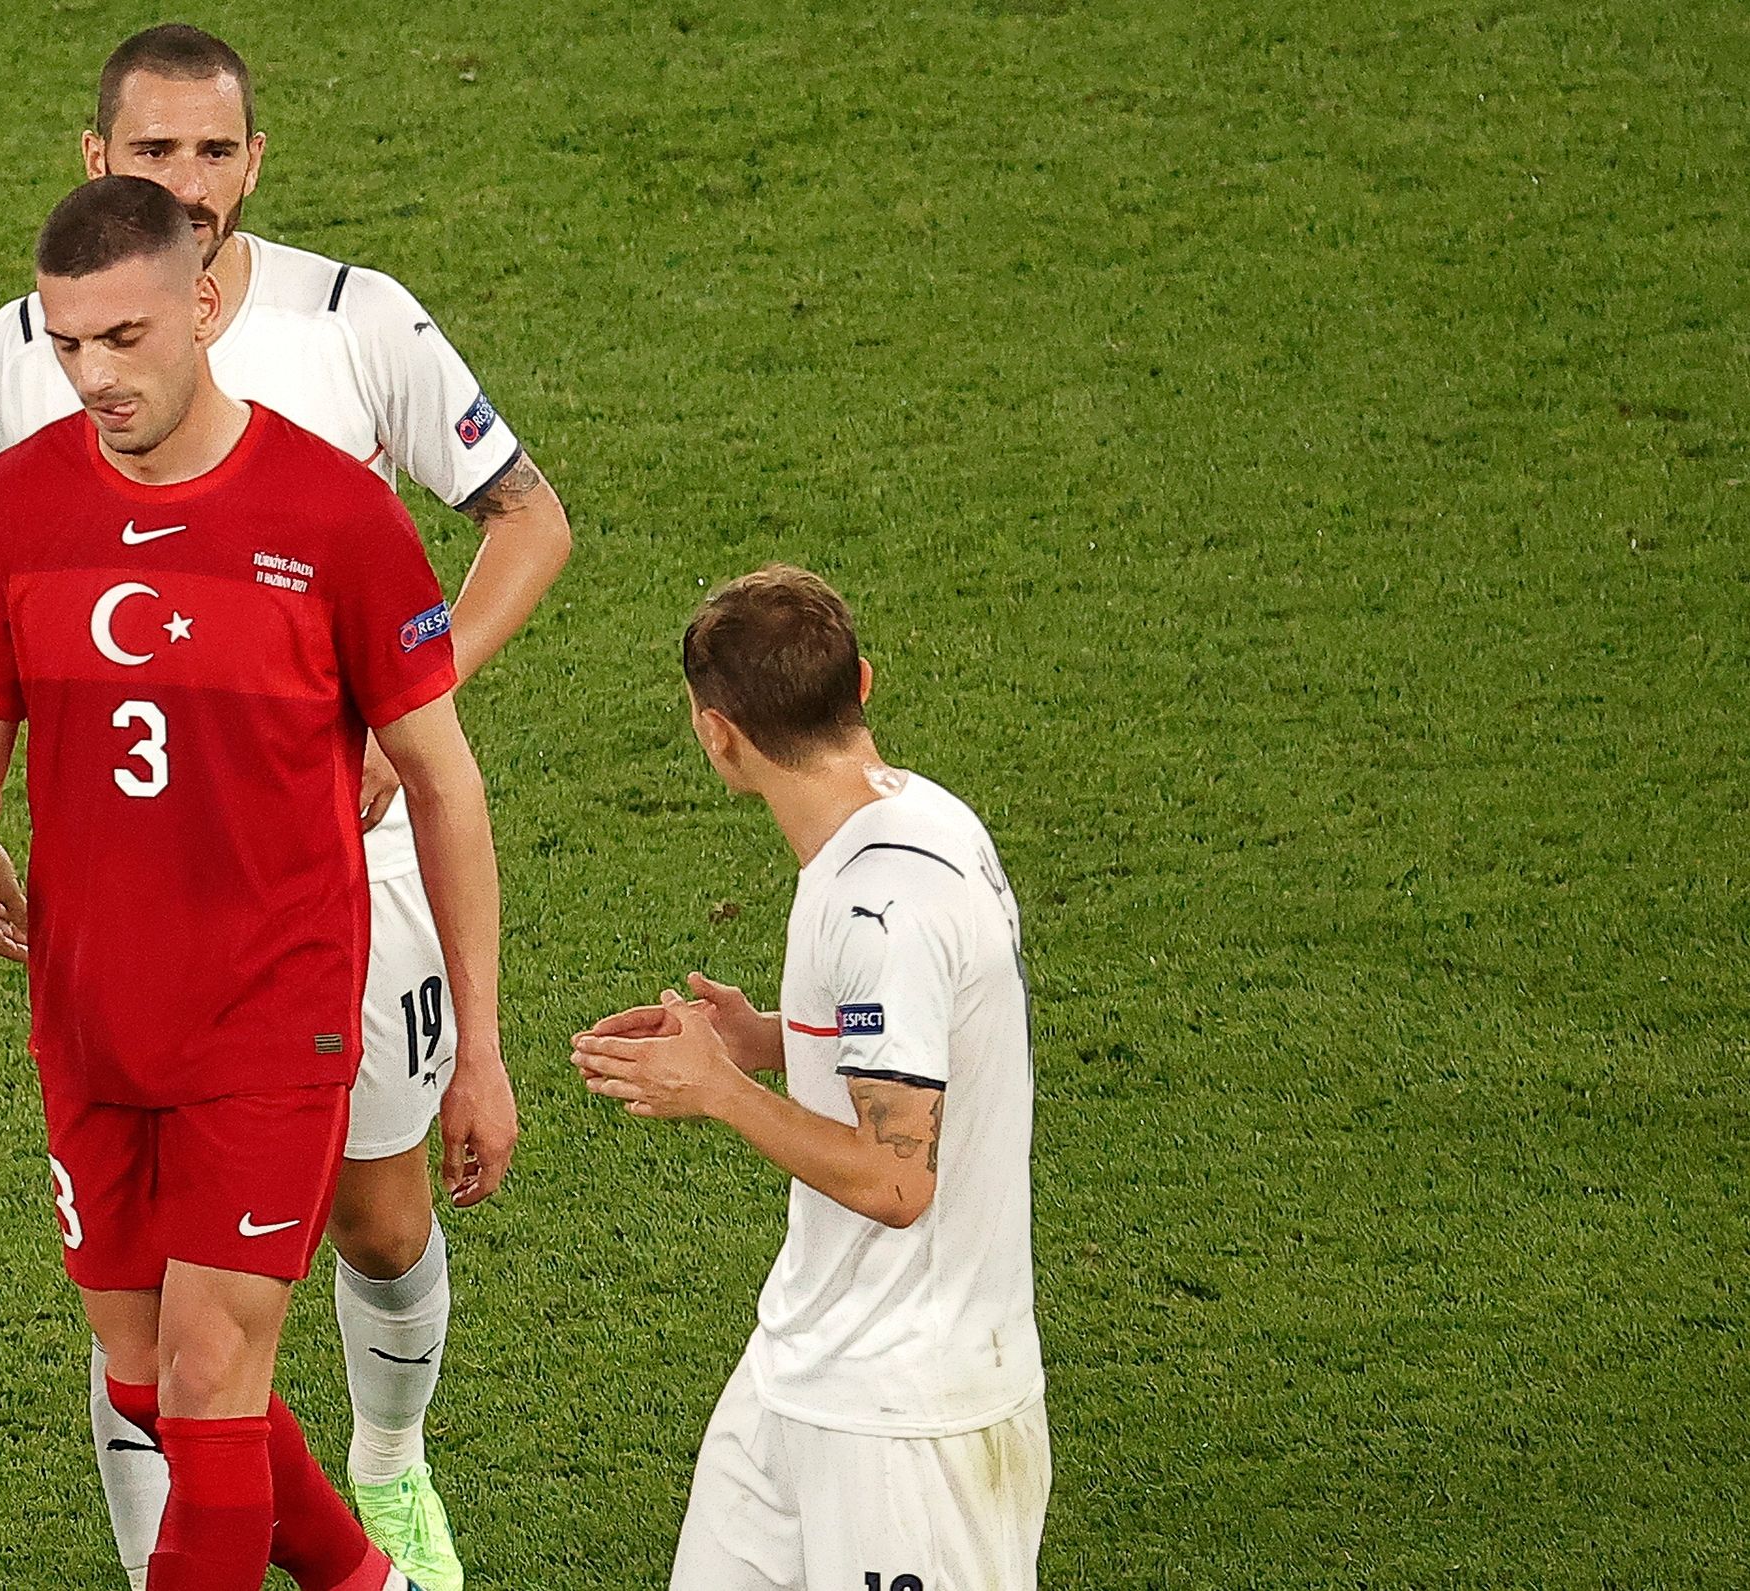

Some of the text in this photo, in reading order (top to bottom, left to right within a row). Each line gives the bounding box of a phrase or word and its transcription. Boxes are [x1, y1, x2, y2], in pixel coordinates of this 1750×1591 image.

[112, 700, 168, 798] 3
[400, 975, 442, 1079] 19
[842, 1012, 883, 1027] ESPECT
[49, 1153, 83, 1250] 3
